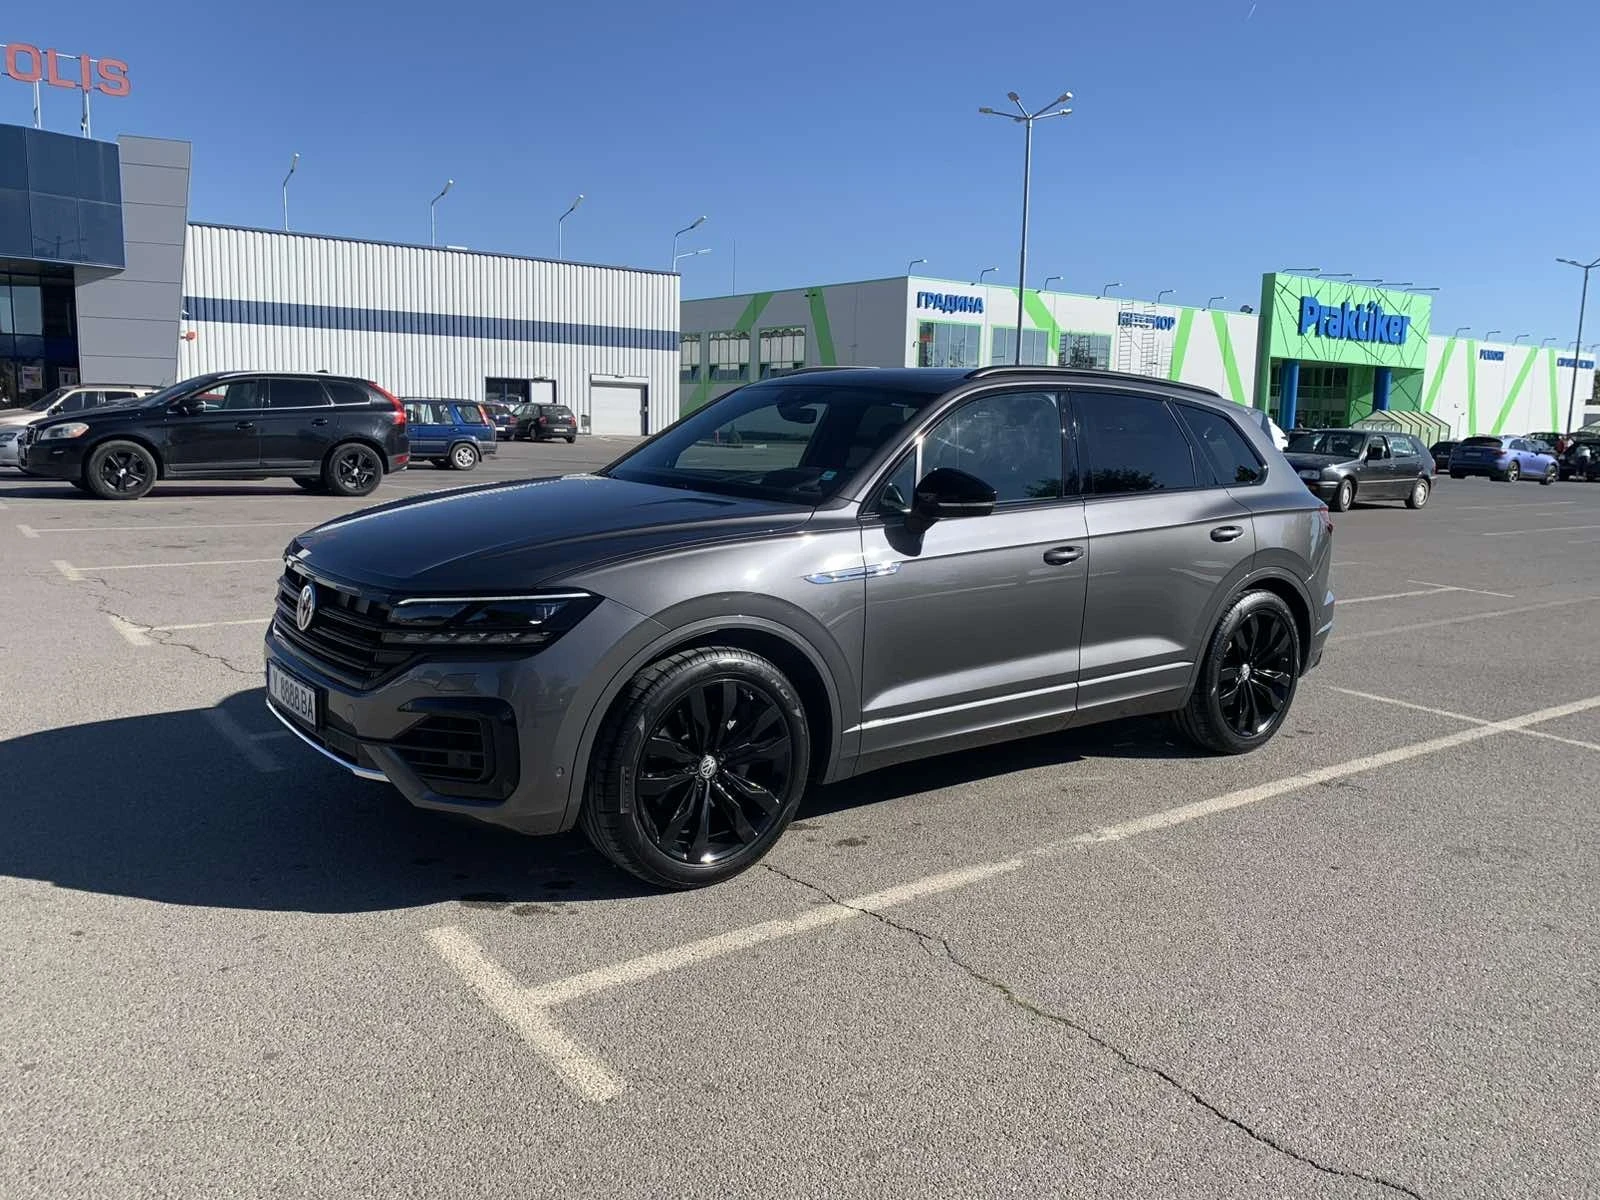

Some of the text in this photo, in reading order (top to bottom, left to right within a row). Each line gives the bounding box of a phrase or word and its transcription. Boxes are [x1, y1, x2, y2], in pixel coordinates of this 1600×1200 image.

[5, 42, 131, 97] OLIS
[916, 291, 984, 314] ГРАДИНА
[1297, 295, 1411, 346] Praktiker
